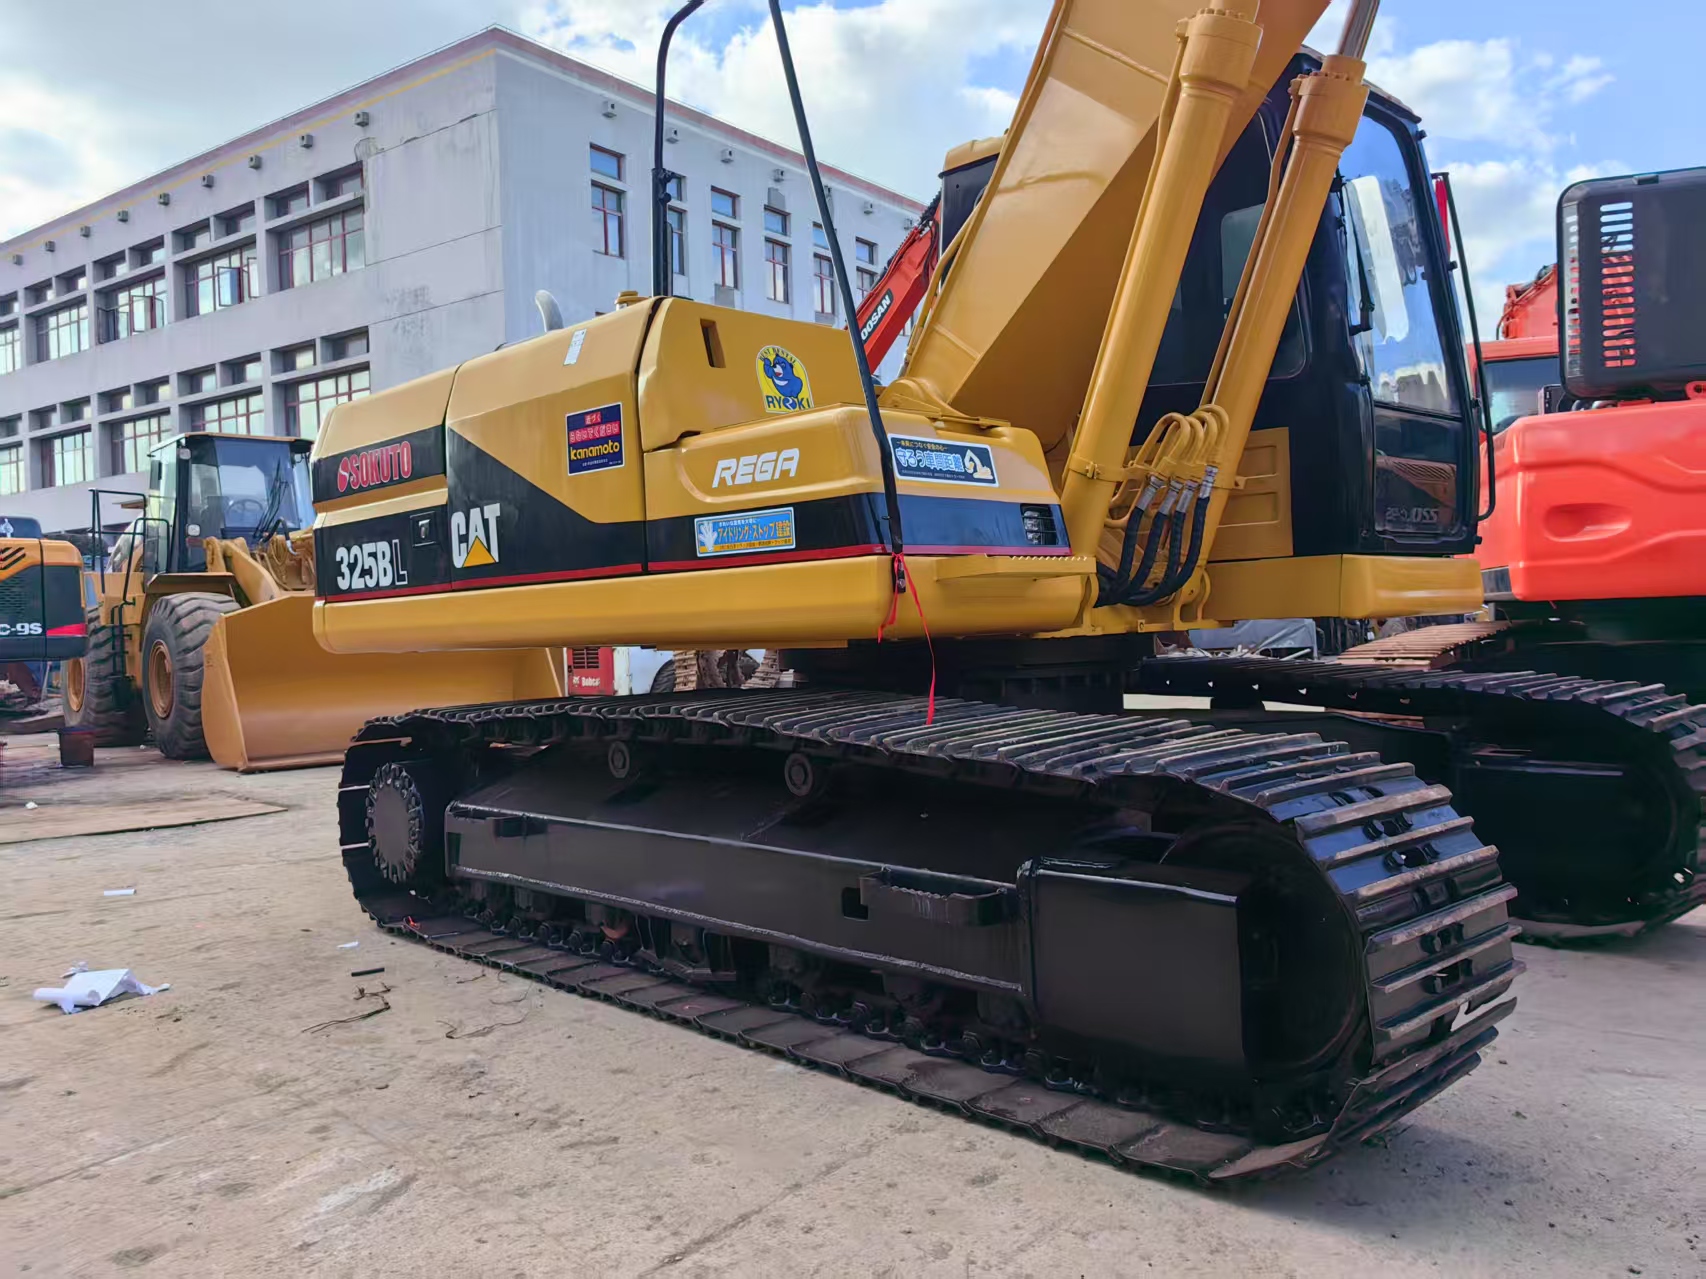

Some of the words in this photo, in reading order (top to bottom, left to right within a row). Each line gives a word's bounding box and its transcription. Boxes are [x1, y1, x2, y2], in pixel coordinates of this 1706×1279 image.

[350, 441, 412, 489] SOKUTO
[570, 440, 620, 460] kanamoto
[712, 447, 800, 488] REGA
[895, 447, 965, 472] 守ろう車間距離
[451, 503, 500, 569] CAT
